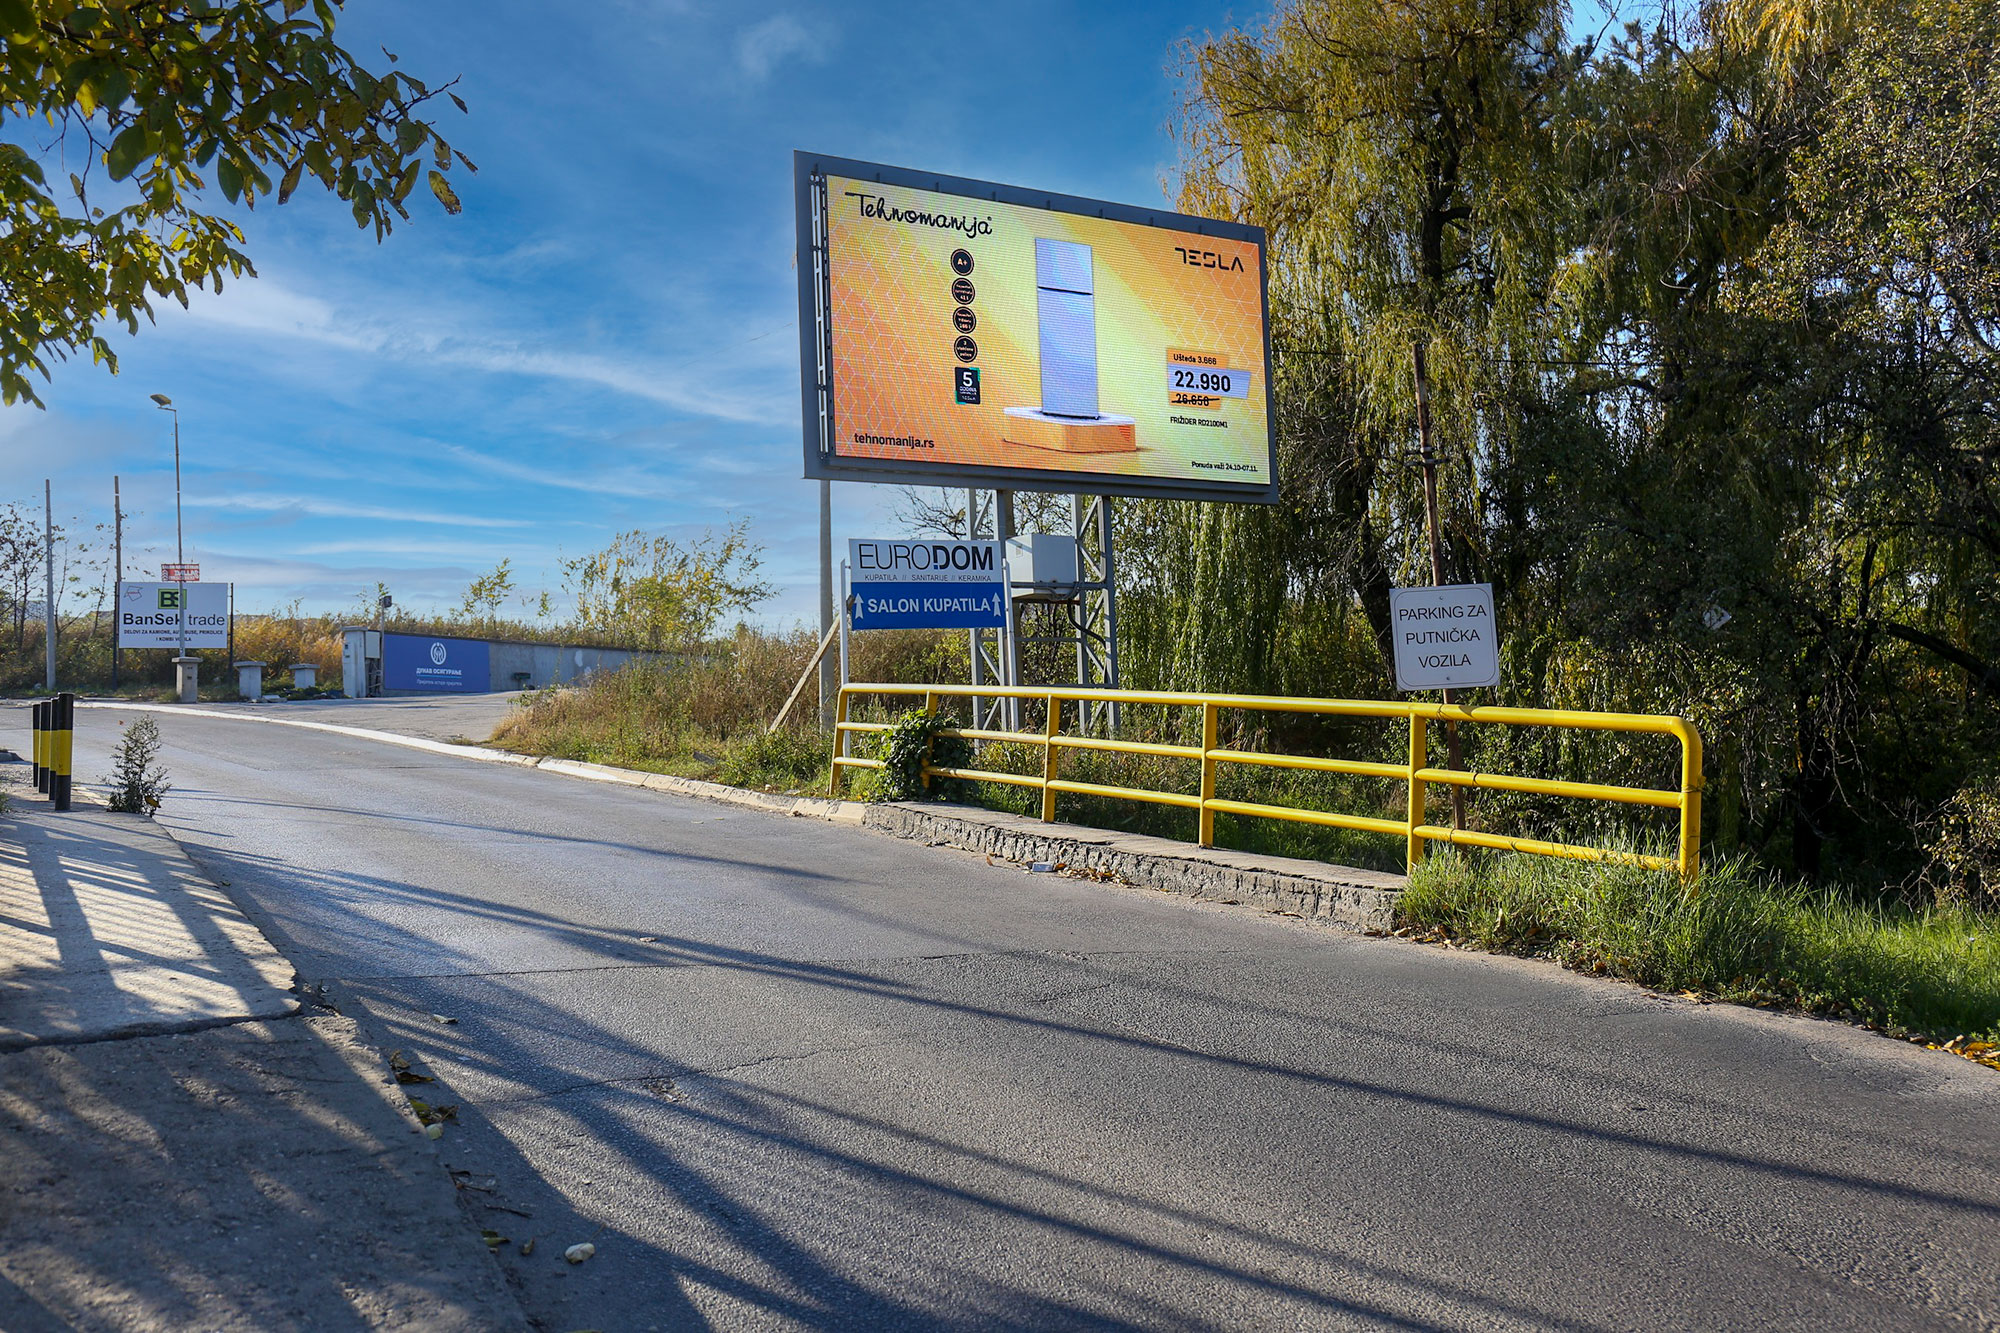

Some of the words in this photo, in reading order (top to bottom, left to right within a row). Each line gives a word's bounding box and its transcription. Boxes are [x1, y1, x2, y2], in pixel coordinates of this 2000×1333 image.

[845, 192, 992, 239] Tehnomanija
[957, 257, 968, 266] A+
[1174, 247, 1244, 272] TESLA
[1173, 353, 1196, 363] Ušteda
[963, 371, 973, 387] 5
[1174, 370, 1231, 392] 22.990
[1170, 415, 1197, 426] FRIŽIDER
[853, 432, 934, 449] tehnomanija.rs
[1191, 461, 1213, 469] Ponuda
[858, 544, 993, 571] EURODOM
[911, 574, 948, 582] SANITARIJE
[868, 598, 919, 613] SALON
[923, 597, 991, 612] KUPATILA
[1399, 606, 1464, 621] PARKING
[1467, 604, 1487, 617] ZA
[188, 614, 225, 625] trade
[1405, 627, 1481, 645] PUTNIČKA
[1418, 654, 1472, 668] VOZILA
[416, 667, 432, 675] ДУНАВ
